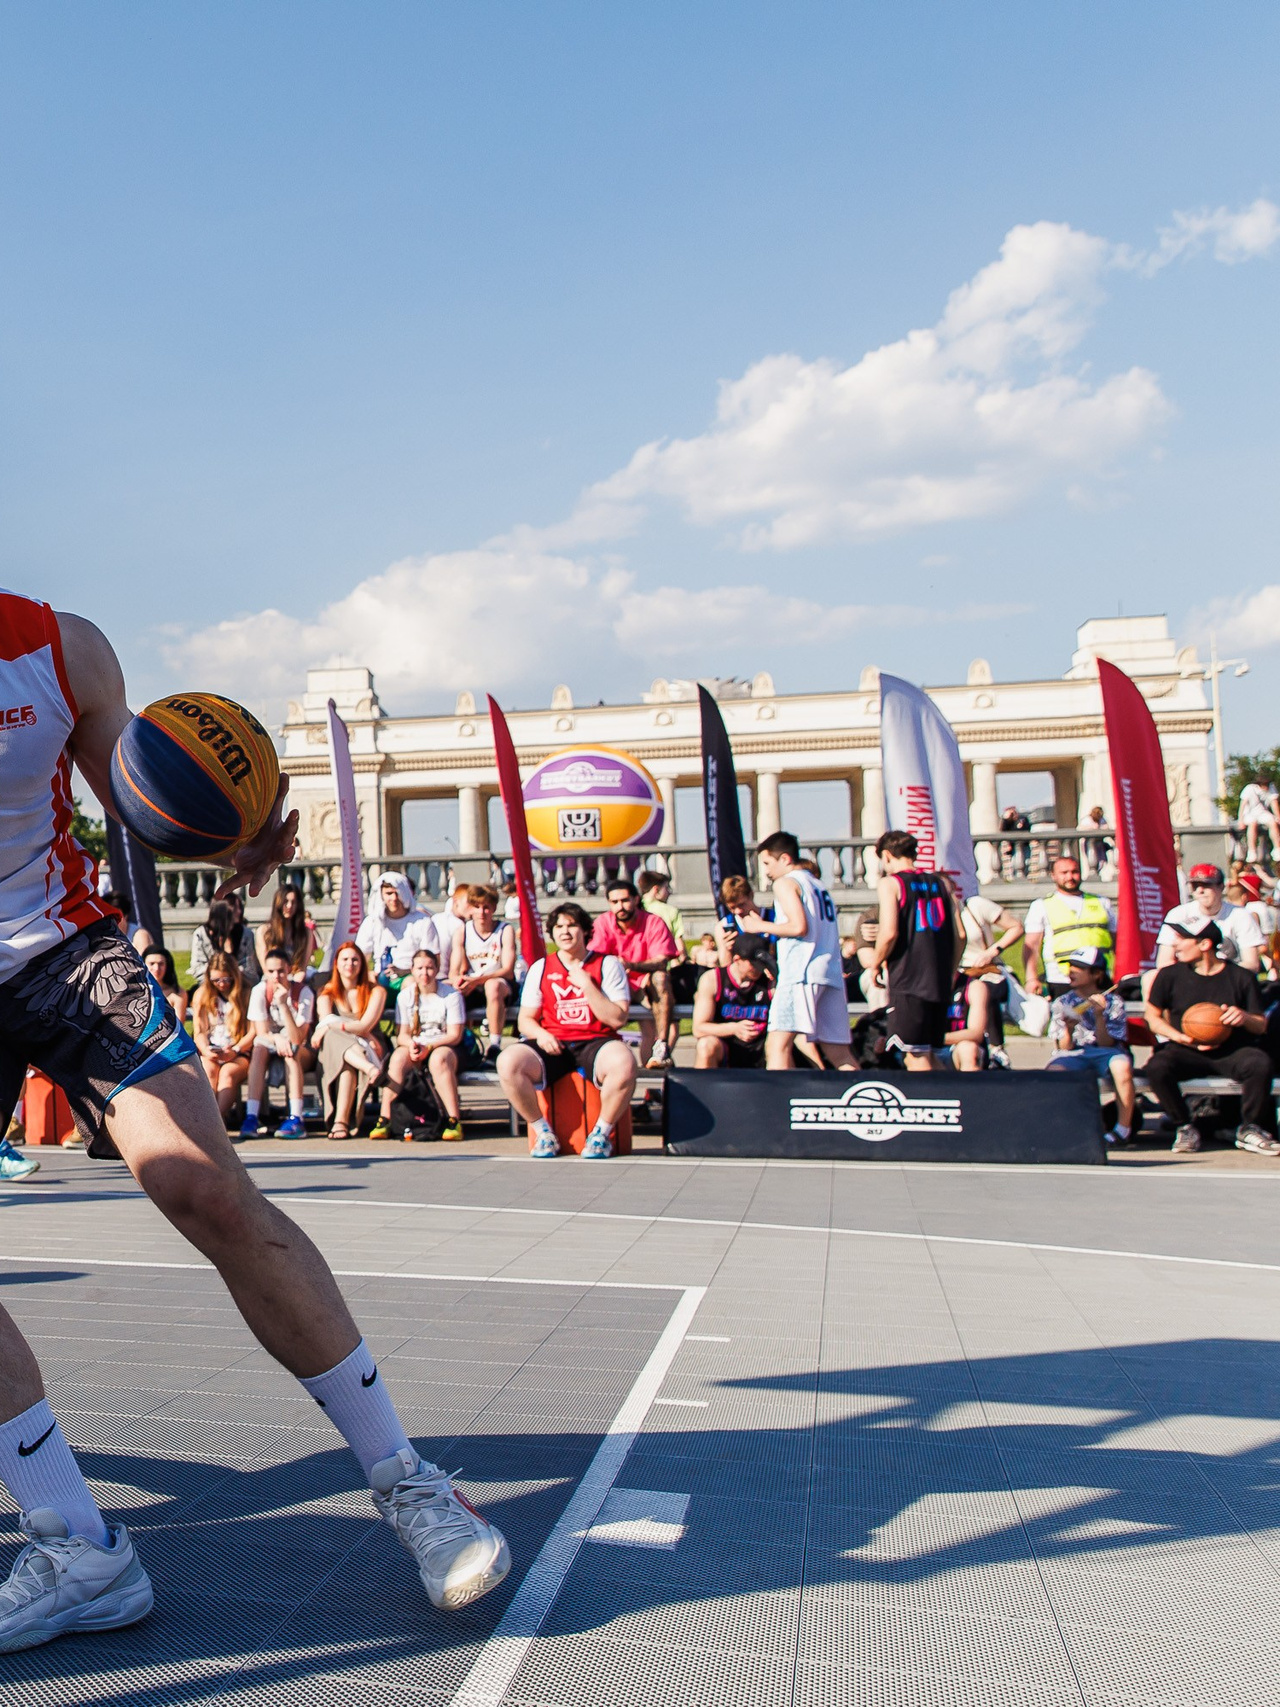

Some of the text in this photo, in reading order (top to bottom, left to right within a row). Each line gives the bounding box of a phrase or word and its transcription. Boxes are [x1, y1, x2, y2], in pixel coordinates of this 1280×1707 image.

[166, 698, 252, 787] Wilson
[814, 888, 836, 922] 16
[790, 1107, 962, 1124] STREETBASKET
